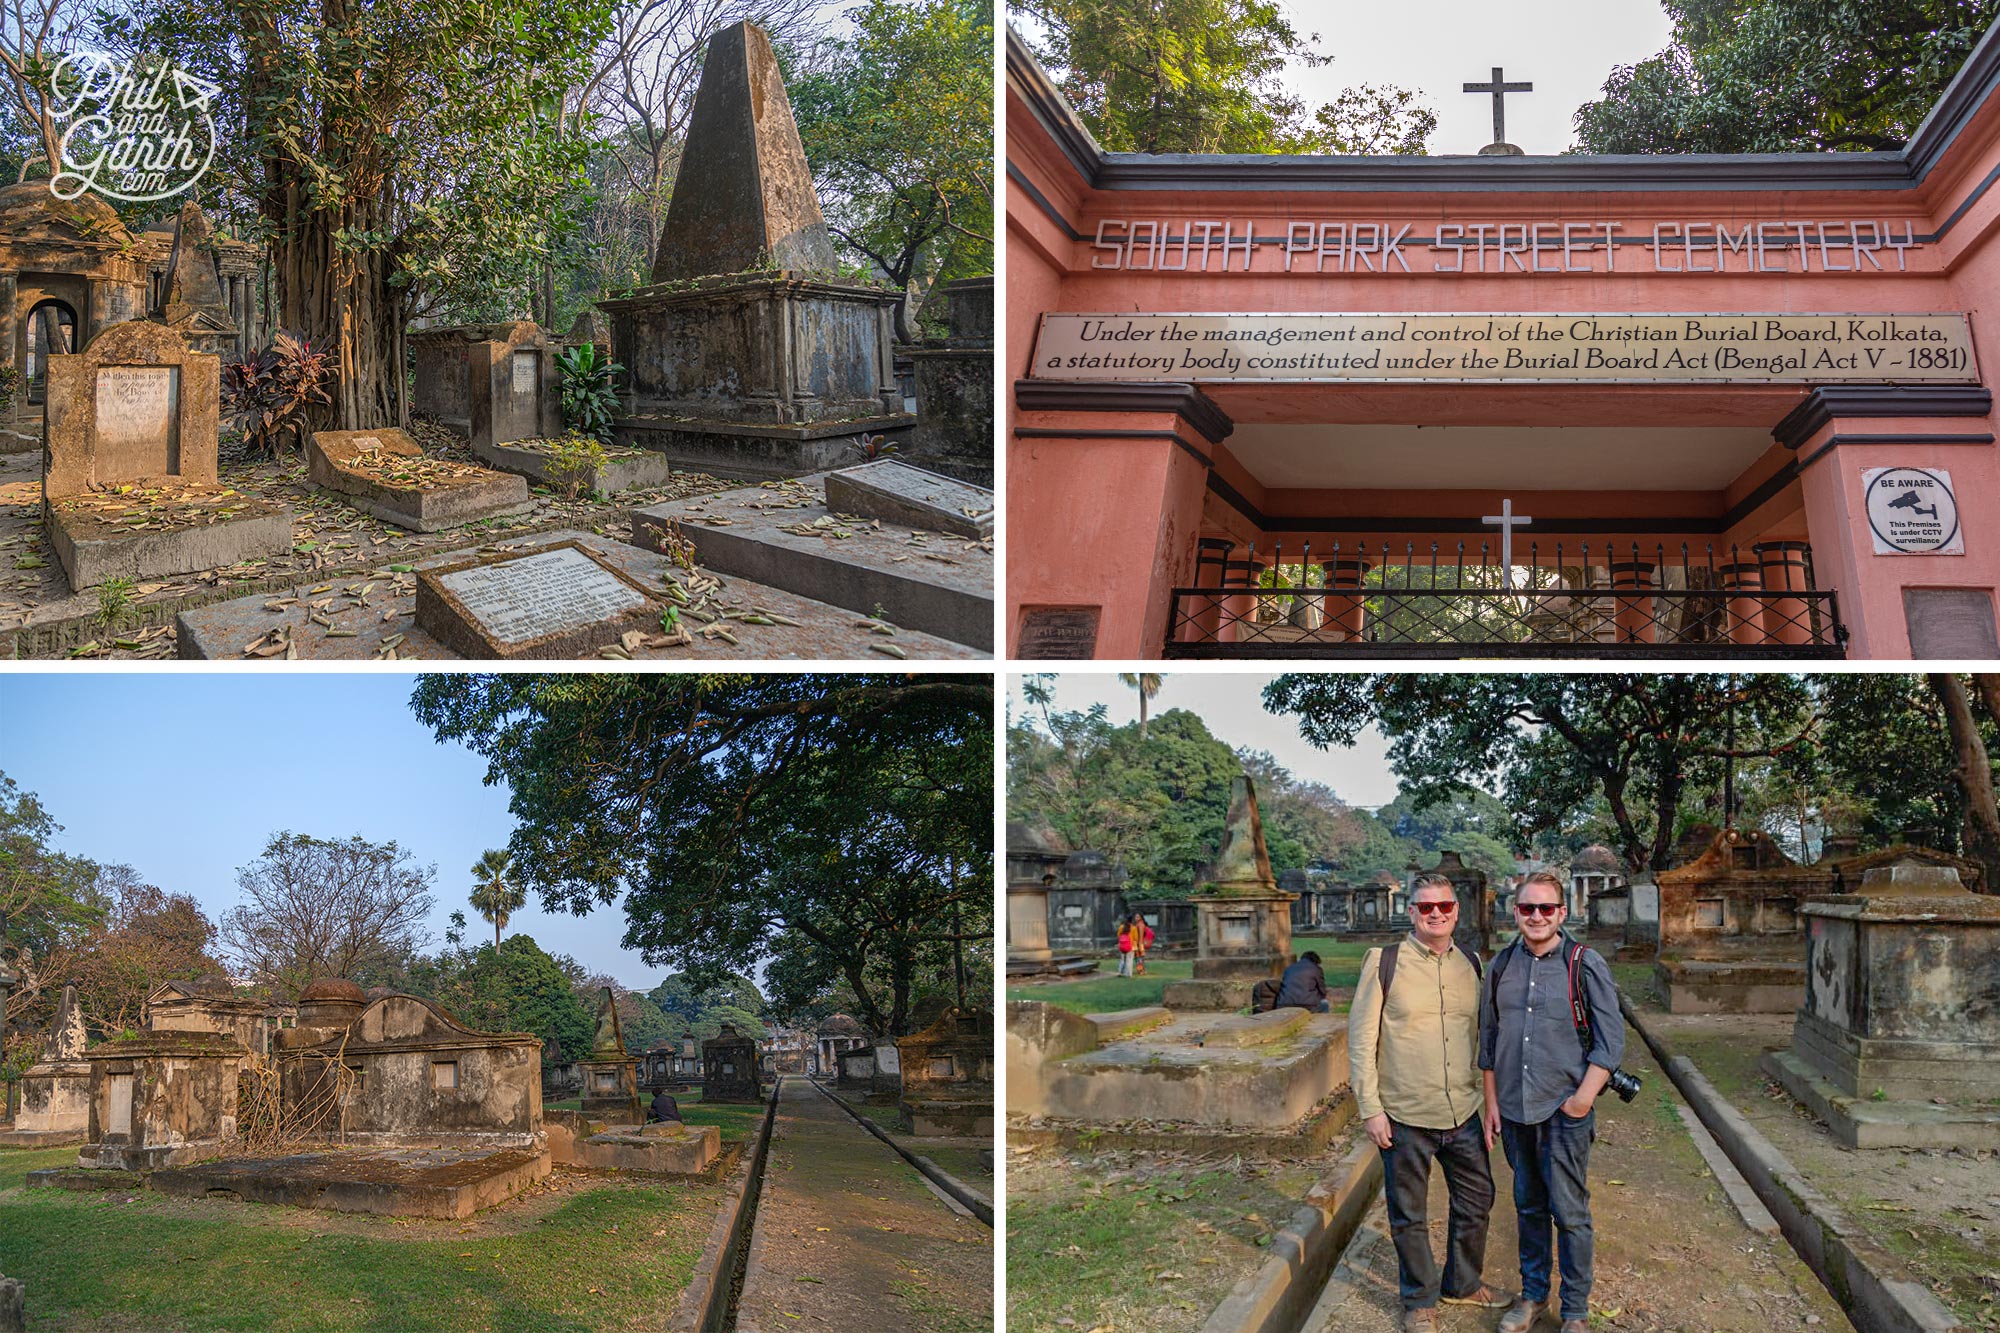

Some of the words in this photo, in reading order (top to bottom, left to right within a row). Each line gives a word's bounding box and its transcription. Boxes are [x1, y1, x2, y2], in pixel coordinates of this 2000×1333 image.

[1091, 219, 1253, 271] SOUTH
[1285, 221, 1413, 273] PARK
[1434, 223, 1622, 273] STREET
[1653, 220, 1914, 272] CEMETERY
[1080, 321, 1155, 341] Under
[1160, 321, 1198, 341] the
[1202, 325, 1356, 346] management
[1361, 321, 1406, 341] and
[1411, 321, 1493, 341] control
[1498, 321, 1522, 341] of
[1527, 321, 1564, 341] the
[1569, 320, 1677, 341] Christian
[1684, 320, 1759, 341] Burial
[1764, 320, 1842, 344] Board,
[1846, 320, 1948, 344] Kolkata,
[1047, 356, 1061, 368] a
[1066, 352, 1175, 373] statutory
[1180, 348, 1241, 373] body
[1247, 348, 1381, 369] constituted
[1386, 348, 1456, 369] under
[1461, 348, 1499, 369] the
[1504, 348, 1579, 369] Burial
[1584, 348, 1659, 369] Board
[1663, 347, 1708, 369] Act
[1714, 346, 1807, 374] (Bengal
[1812, 347, 1858, 369] Act
[1863, 348, 1886, 369] V
[1908, 346, 1967, 372] 1881)
[1881, 480, 1895, 488] BE
[1898, 480, 1934, 488] AWARE
